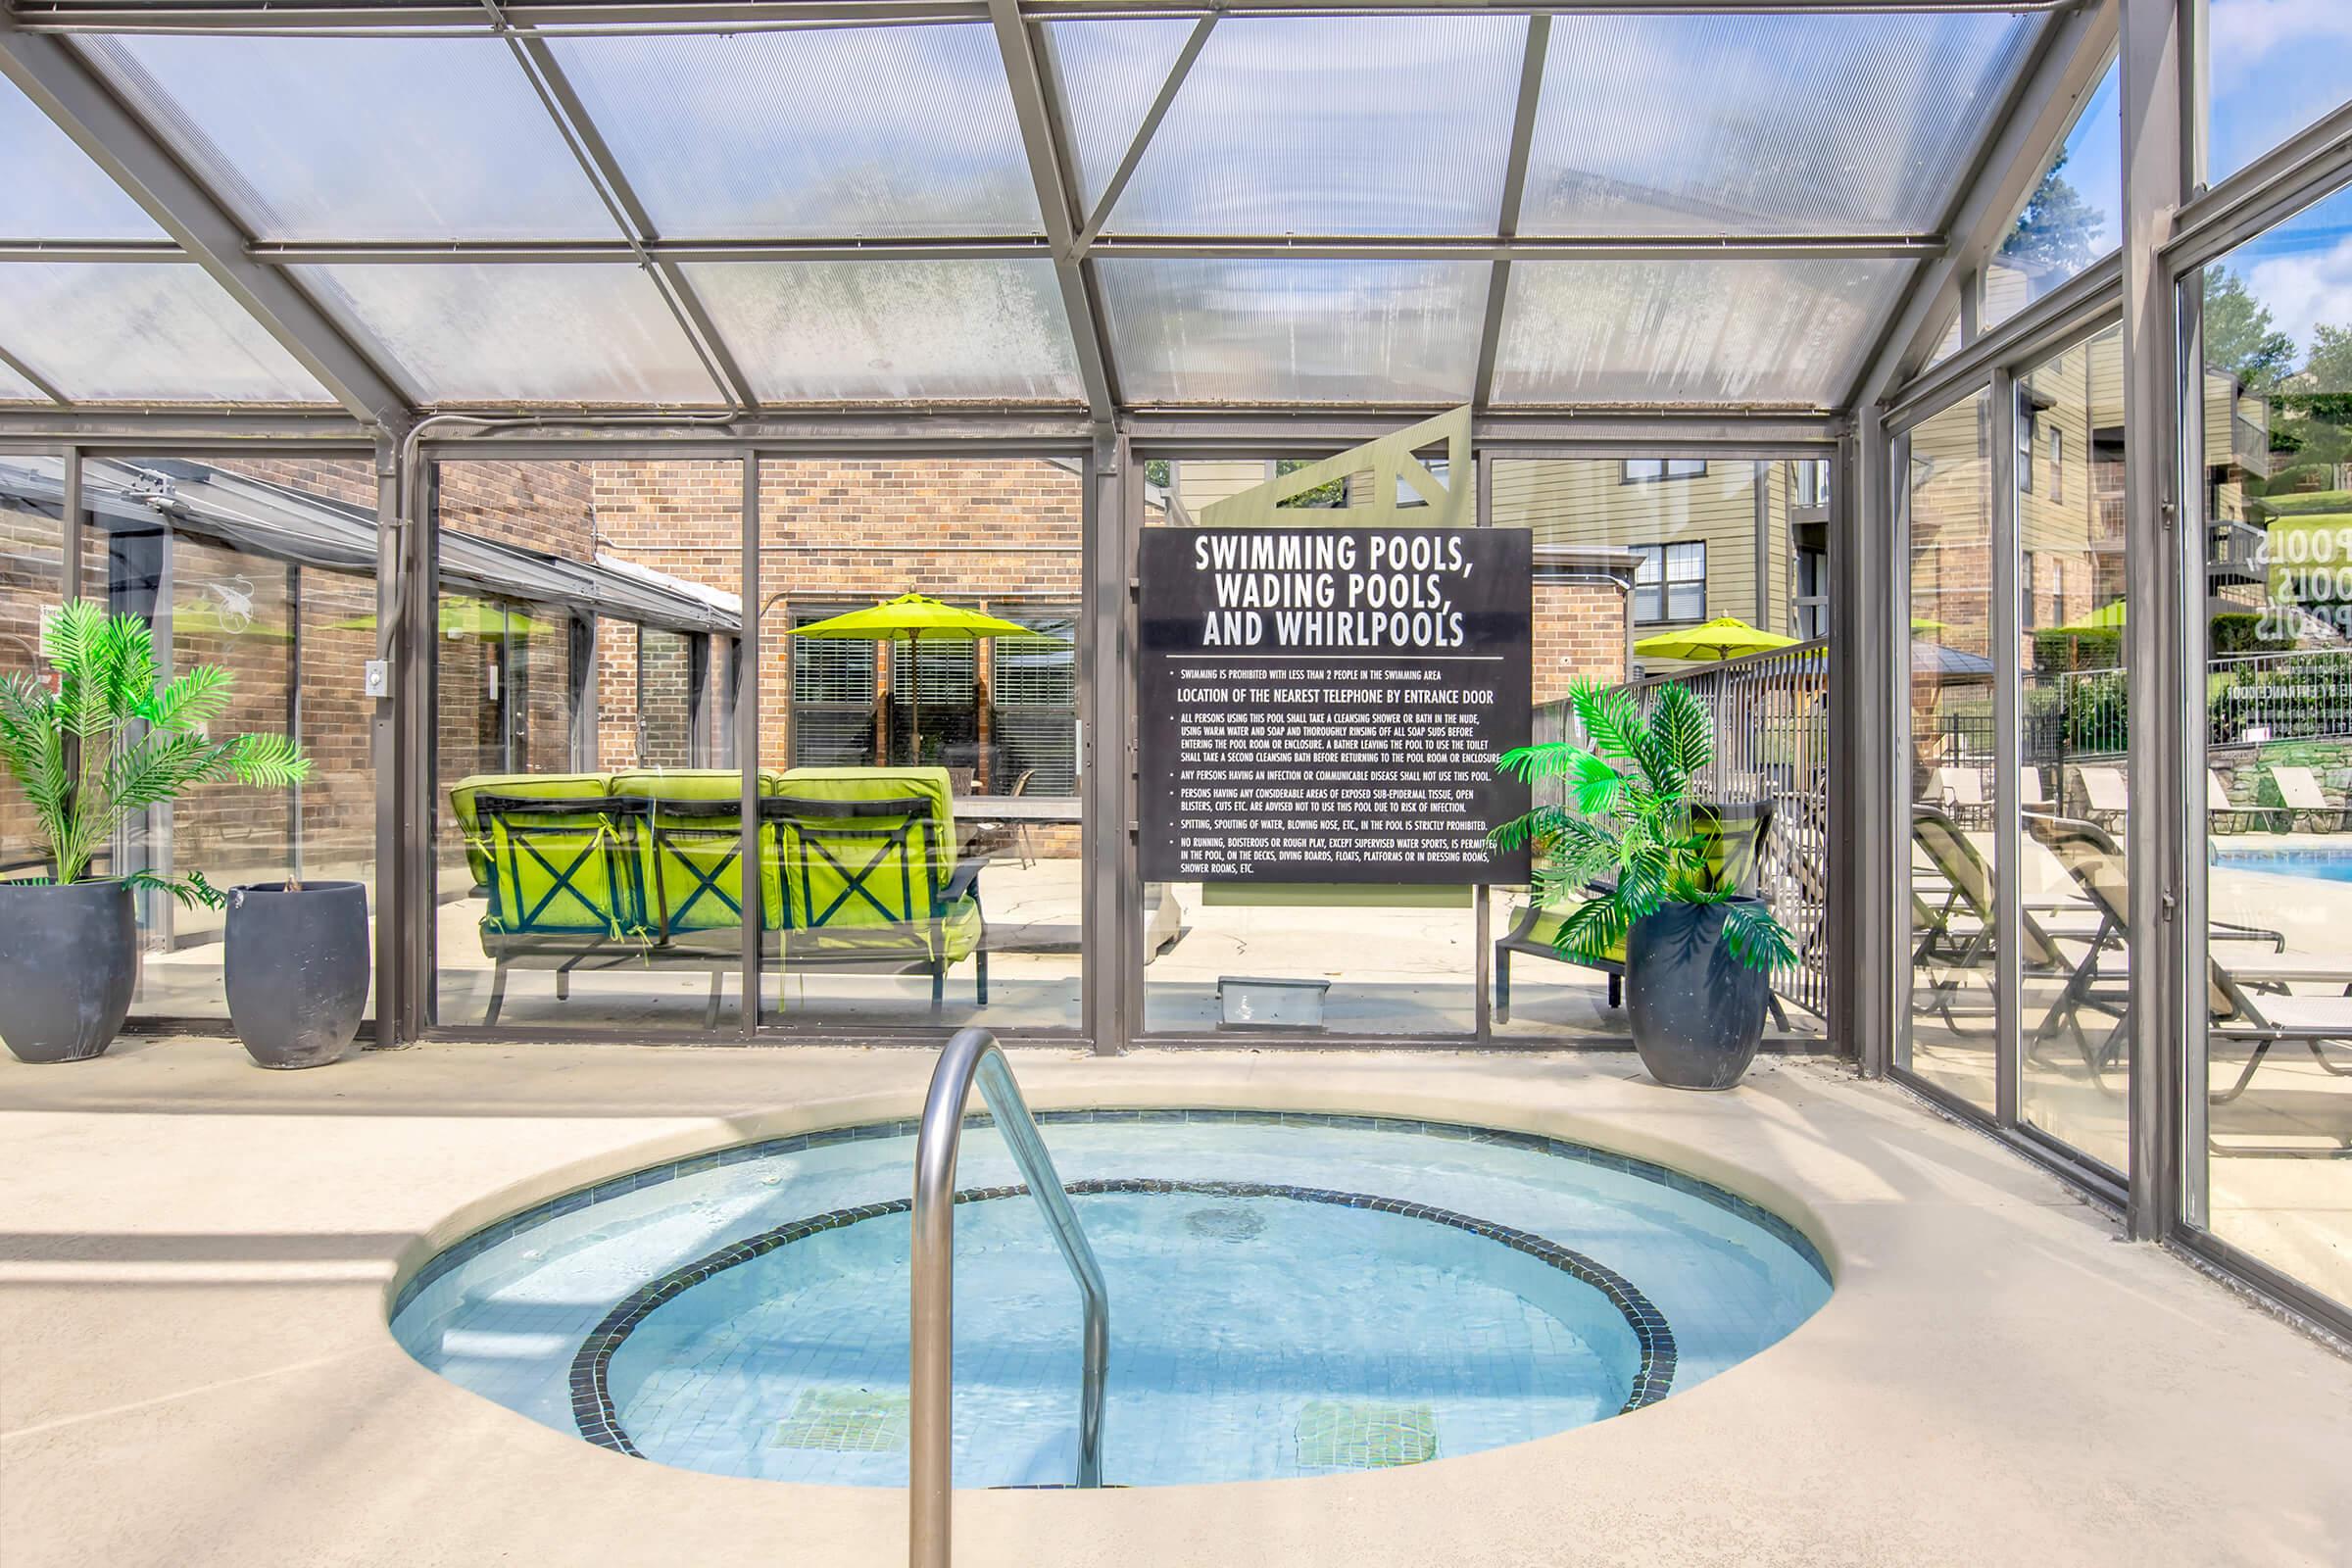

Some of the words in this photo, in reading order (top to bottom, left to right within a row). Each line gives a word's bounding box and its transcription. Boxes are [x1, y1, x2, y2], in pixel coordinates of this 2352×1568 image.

[1196, 536, 1355, 569] SWIMMING
[1371, 537, 1472, 578] POOLS,
[1216, 574, 1334, 607] WADING
[1349, 574, 1450, 615] POOLS,
[1204, 612, 1261, 645] AND
[1276, 612, 1462, 646] WHIRLPOOLS
[1181, 669, 1217, 679] SWIMMING
[1229, 669, 1267, 679] PROHIBITED
[1269, 669, 1286, 679] WITH
[1289, 669, 1304, 679] LESS
[1306, 669, 1324, 679] THAN
[1327, 669, 1331, 680] 2
[1334, 669, 1357, 680] PEOPLE
[1370, 670, 1382, 680] THE
[1385, 670, 1421, 680] SWIMMING
[1423, 670, 1442, 680] AREA
[1178, 688, 1228, 702] LOCATION
[1233, 688, 1246, 703] OF
[1250, 688, 1269, 703] THE
[1274, 689, 1320, 703] NEAREST
[1323, 689, 1382, 703] TELEPHONE
[1388, 689, 1400, 704] BY
[1405, 690, 1458, 704] ENTRANCE
[1463, 690, 1493, 704] DOOR
[1180, 712, 1193, 722] ALL
[1195, 712, 1224, 723] PERSONS
[1227, 712, 1248, 723] USING
[1250, 712, 1264, 723] THIS
[1267, 712, 1285, 723] POOL
[1287, 713, 1307, 723] SHALL
[1308, 713, 1324, 723] TAKE
[1334, 713, 1370, 723] CLEANSING
[1372, 713, 1400, 723] SHOWER
[1403, 713, 1412, 723] OR
[1416, 713, 1432, 723] BATH
[1444, 713, 1456, 723] THE
[1459, 713, 1480, 725] NUDE,
[1182, 726, 1201, 736] USING
[1203, 726, 1225, 736] WARM
[1227, 726, 1249, 736] WATER
[1250, 726, 1264, 736] AND
[1267, 726, 1285, 736] SOAP
[1286, 726, 1300, 736] AND
[1302, 726, 1348, 736] THOROUGHLY
[1349, 726, 1376, 736] RINSING
[1379, 726, 1391, 736] OFF
[1393, 726, 1405, 737] ALL
[1407, 726, 1425, 737] SOAP
[1428, 726, 1446, 737] SUDS
[1448, 726, 1473, 737] BEFORE
[1181, 739, 1212, 749] ENTERING
[1214, 739, 1227, 749] THE
[1230, 739, 1248, 750] POOL
[1250, 739, 1270, 750] ROOM
[1272, 739, 1282, 750] OR
[1285, 739, 1324, 750] ENCLOSURE.
[1334, 739, 1358, 750] BATHER
[1361, 739, 1388, 750] LEAVING
[1391, 739, 1402, 750] THE
[1405, 739, 1423, 750] POOL
[1437, 739, 1448, 750] USE
[1451, 739, 1463, 750] THE
[1466, 740, 1489, 750] TOILET
[1181, 752, 1201, 761] SHALL
[1202, 752, 1218, 761] TAKE
[1228, 752, 1253, 762] SECOND
[1256, 752, 1292, 762] CLEANSING
[1295, 753, 1310, 762] BATH
[1313, 753, 1338, 762] BEFORE
[1341, 753, 1378, 762] RETURNING
[1392, 753, 1403, 762] THE
[1407, 753, 1424, 762] POOL
[1427, 753, 1447, 762] ROOM
[1450, 753, 1459, 763] OR
[1180, 770, 1195, 780] ANY
[1197, 770, 1227, 780] PERSONS
[1229, 770, 1253, 780] HAVING
[1267, 770, 1300, 780] INFECTION
[1303, 770, 1313, 780] OR
[1316, 770, 1368, 780] COMMUNICABLE
[1371, 771, 1397, 781] DISEASE
[1400, 771, 1421, 781] SHALL
[1423, 771, 1437, 781] NOT
[1439, 771, 1450, 781] USE
[1453, 771, 1468, 781] THIS
[1472, 771, 1492, 781] POOL.
[1181, 788, 1211, 798] PERSONS
[1213, 788, 1238, 799] HAVING
[1240, 788, 1254, 799] ANY
[1256, 788, 1303, 799] CONSIDERABLE
[1305, 789, 1327, 799] AREAS
[1330, 789, 1338, 799] OF
[1342, 789, 1370, 799] EXPOSED
[1374, 789, 1426, 799] SUB-EPIDERMAL
[1428, 789, 1453, 802] TISSUE,
[1456, 789, 1473, 800] OPEN
[1181, 801, 1213, 812] BLISTERS,
[1215, 801, 1232, 810] CUTS
[1235, 802, 1248, 811] ETC.
[1250, 802, 1262, 811] ARE
[1264, 802, 1293, 811] ADVISED
[1296, 802, 1309, 811] NOT
[1322, 802, 1334, 811] USE
[1337, 802, 1351, 811] THIS
[1354, 802, 1372, 811] POOL
[1375, 802, 1387, 811] DUE
[1401, 802, 1416, 812] RISK
[1419, 802, 1427, 812] OF
[1431, 803, 1466, 812] INFECTION.
[1181, 819, 1212, 831] SPITTING,
[1214, 819, 1247, 829] SPOUTING
[1250, 819, 1258, 829] OF
[1261, 819, 1285, 831] WATER,
[1288, 820, 1317, 830] BLOWING
[1320, 820, 1340, 832] NOSE,
[1343, 820, 1358, 832] ETC.,
[1370, 820, 1383, 830] THE
[1386, 820, 1403, 830] POOL
[1415, 820, 1445, 830] STRICTLY
[1446, 820, 1488, 831] PROHIBITED.
[1181, 837, 1191, 847] NO
[1194, 837, 1225, 850] RUNNING,
[1228, 838, 1268, 848] BOISTEROUS
[1271, 838, 1280, 848] OR
[1284, 838, 1306, 848] ROUGH
[1309, 838, 1326, 850] PLAY,
[1329, 838, 1352, 848] EXCEPT
[1355, 838, 1395, 848] SUPERVISED
[1397, 838, 1418, 848] WATER
[1421, 839, 1448, 851] SPORTS,
[1190, 850, 1201, 859] THE
[1205, 850, 1224, 862] POOL,
[1239, 851, 1250, 860] THE
[1254, 851, 1277, 862] DECKS,
[1280, 851, 1301, 860] DIVING
[1304, 851, 1333, 862] BOARDS,
[1336, 851, 1361, 862] FLOATS,
[1364, 852, 1402, 861] PLATFORMS
[1427, 852, 1459, 861] DRESSING
[1463, 852, 1490, 863] ROOMS,
[1181, 862, 1208, 873] SHOWER
[1211, 862, 1238, 875] ROOMS,
[1241, 862, 1253, 873] ETC.
